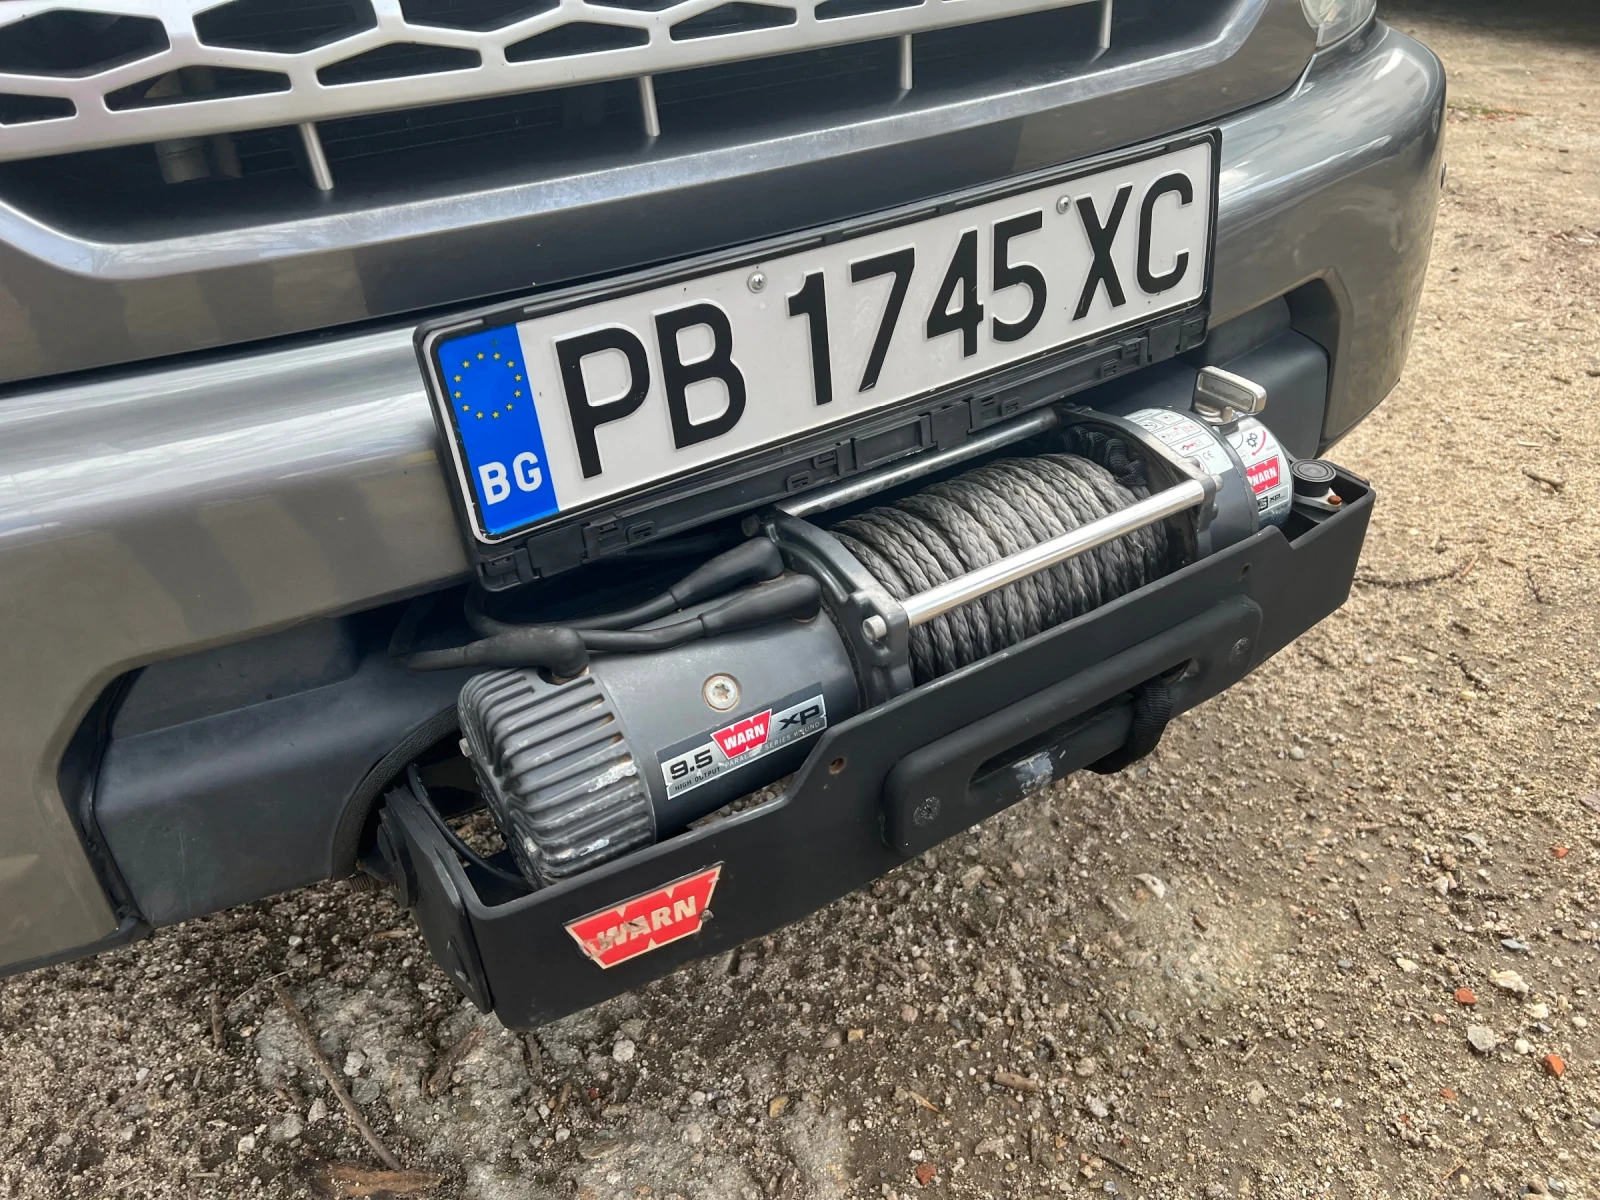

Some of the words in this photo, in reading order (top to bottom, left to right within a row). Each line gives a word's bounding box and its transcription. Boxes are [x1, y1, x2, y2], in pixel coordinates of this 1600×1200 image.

[555, 302, 747, 480] PB
[788, 209, 1047, 406] 1745
[1072, 172, 1194, 321] XC
[477, 451, 543, 506] BG
[670, 749, 713, 780] 9.5
[723, 723, 765, 751] WARN
[778, 704, 820, 731] XP
[675, 779, 692, 791] HIGH
[694, 767, 721, 782] OUTPUT
[764, 735, 791, 751] SERIES
[596, 895, 697, 950] WARN
